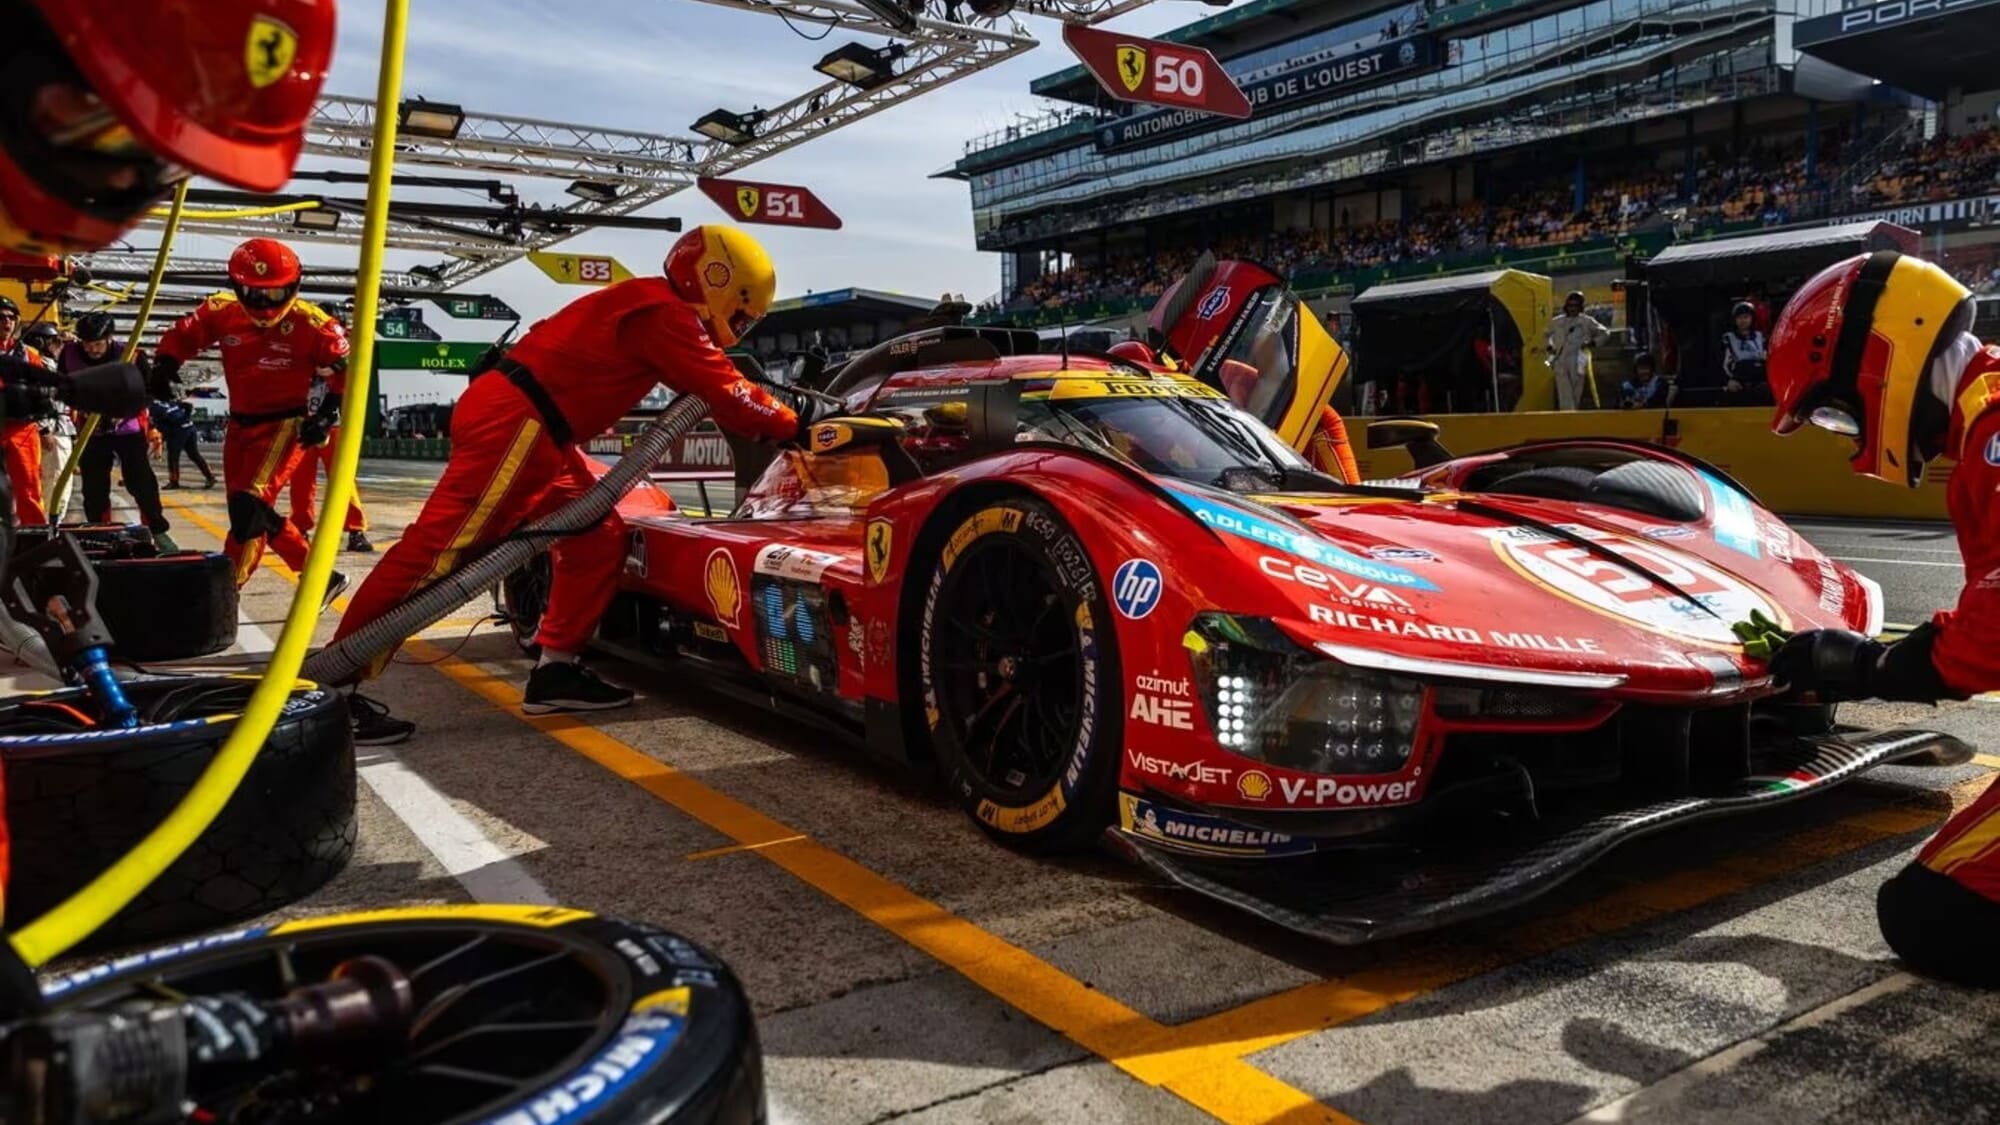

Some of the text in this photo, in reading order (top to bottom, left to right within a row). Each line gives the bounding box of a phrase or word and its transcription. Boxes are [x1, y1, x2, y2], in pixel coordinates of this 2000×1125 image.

[1842, 0, 1975, 31] POR
[1154, 55, 1203, 97] 50
[1123, 109, 1216, 140] AUTOMOBIL
[1274, 79, 1299, 98] DE
[1304, 54, 1383, 91] L'OUEST
[766, 191, 804, 218] 51
[580, 260, 611, 280] 83
[454, 300, 474, 313] 21
[385, 323, 405, 336] 54
[421, 358, 466, 368] ROLEX
[682, 437, 731, 466] MOTUL
[1194, 508, 1416, 584] ADLER GROUP
[1117, 560, 1158, 617] hp
[1329, 593, 1417, 615] LOGISTICS
[1307, 603, 1607, 655] RICHARD MILLE
[1135, 668, 1190, 697] azimut
[1065, 657, 1096, 788] MICHELIN
[1130, 692, 1194, 731] AHE
[1278, 777, 1417, 805] V-Power
[1164, 820, 1292, 844] MICHELIN
